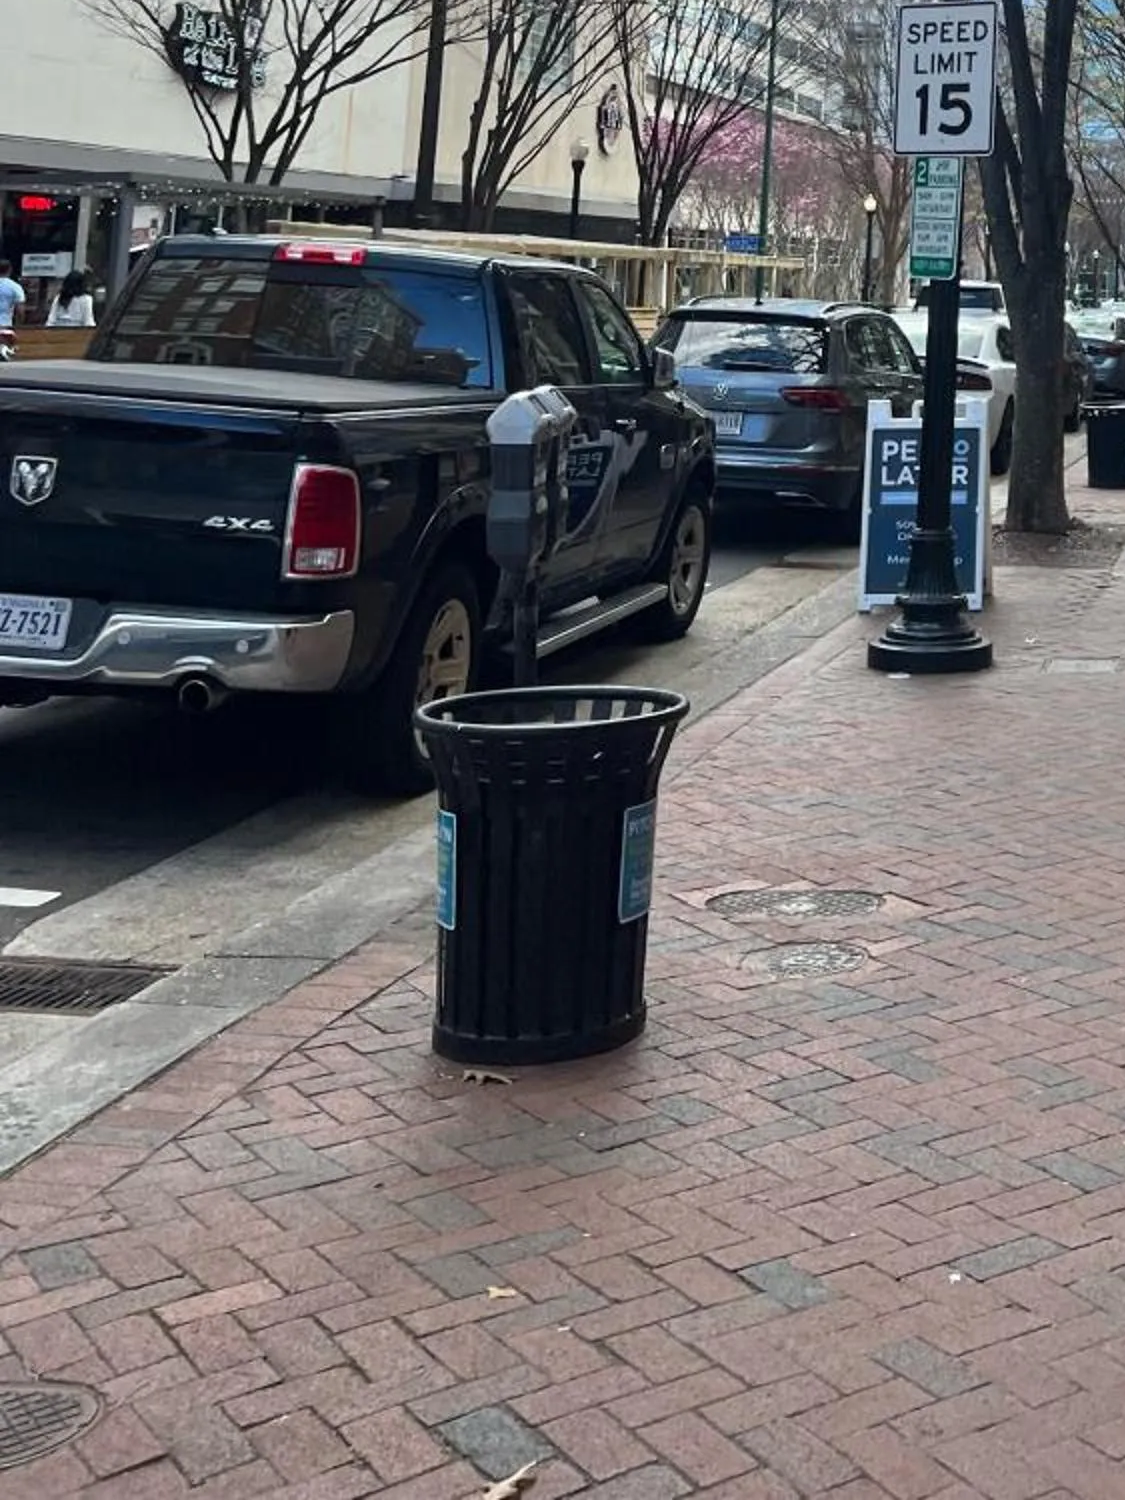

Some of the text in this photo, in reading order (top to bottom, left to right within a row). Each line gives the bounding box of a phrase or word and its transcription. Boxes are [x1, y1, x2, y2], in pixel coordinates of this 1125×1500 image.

[906, 19, 990, 45] SPEED
[913, 51, 979, 76] LIMIT
[915, 82, 973, 137] 15
[917, 160, 927, 184] 2
[882, 439, 969, 462] PEO
[880, 464, 968, 486] LAR
